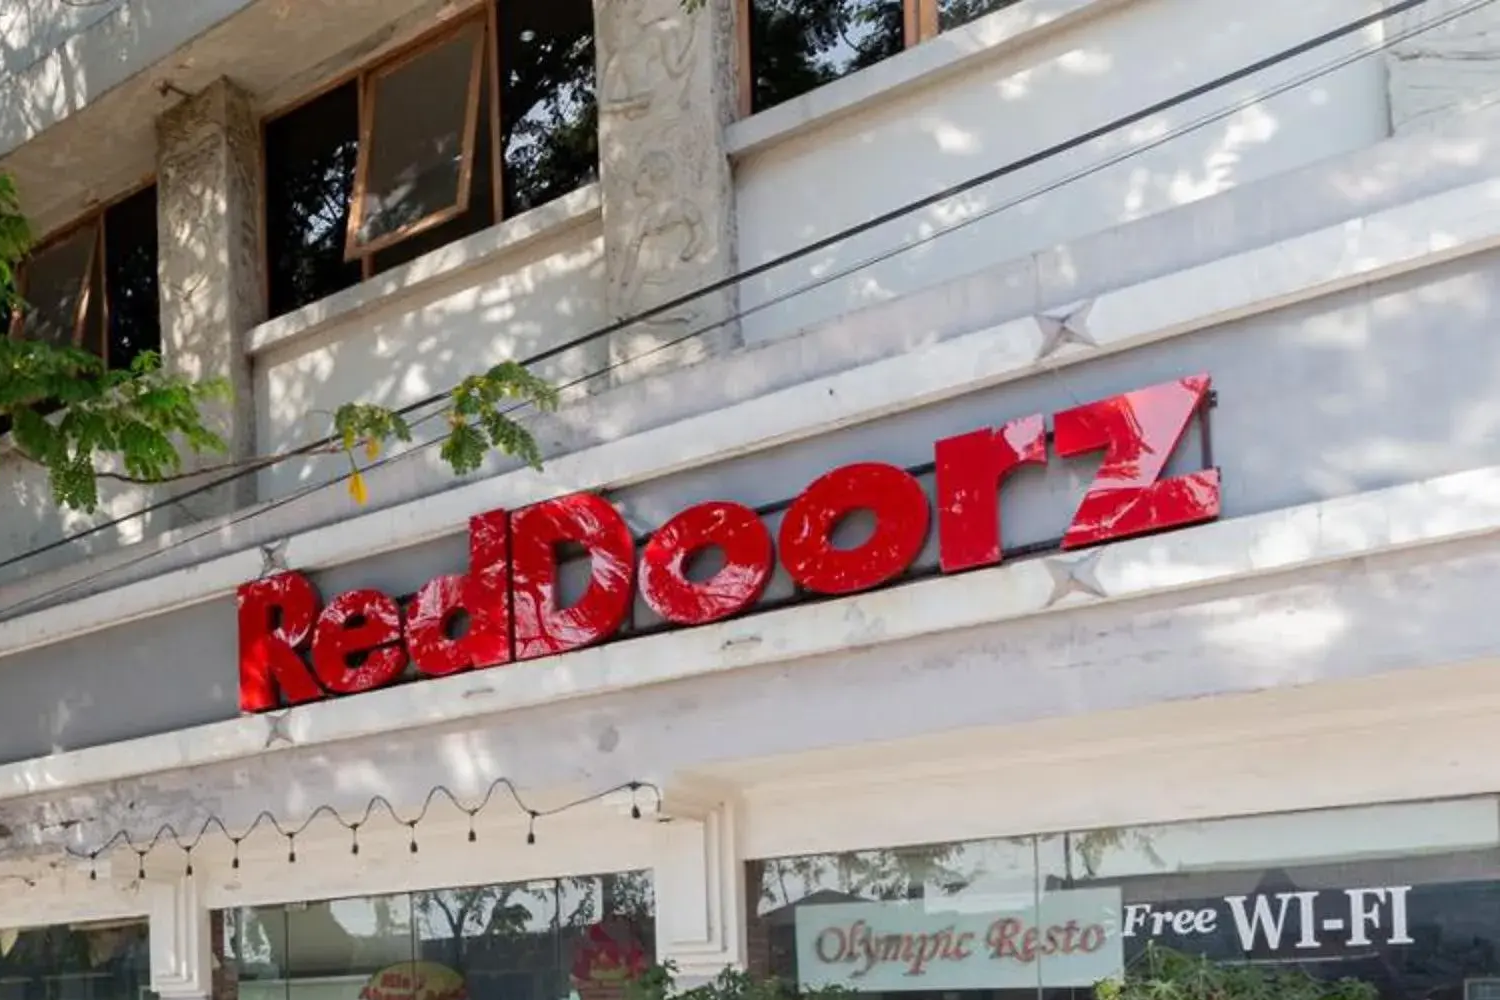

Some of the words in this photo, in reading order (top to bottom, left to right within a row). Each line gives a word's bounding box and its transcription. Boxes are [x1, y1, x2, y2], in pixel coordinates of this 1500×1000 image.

[237, 372, 1222, 713] RedDoorz
[815, 918, 975, 979] Olympic
[986, 916, 1108, 963] Resto
[1121, 903, 1218, 938] Free
[1224, 885, 1415, 951] WI-FI
